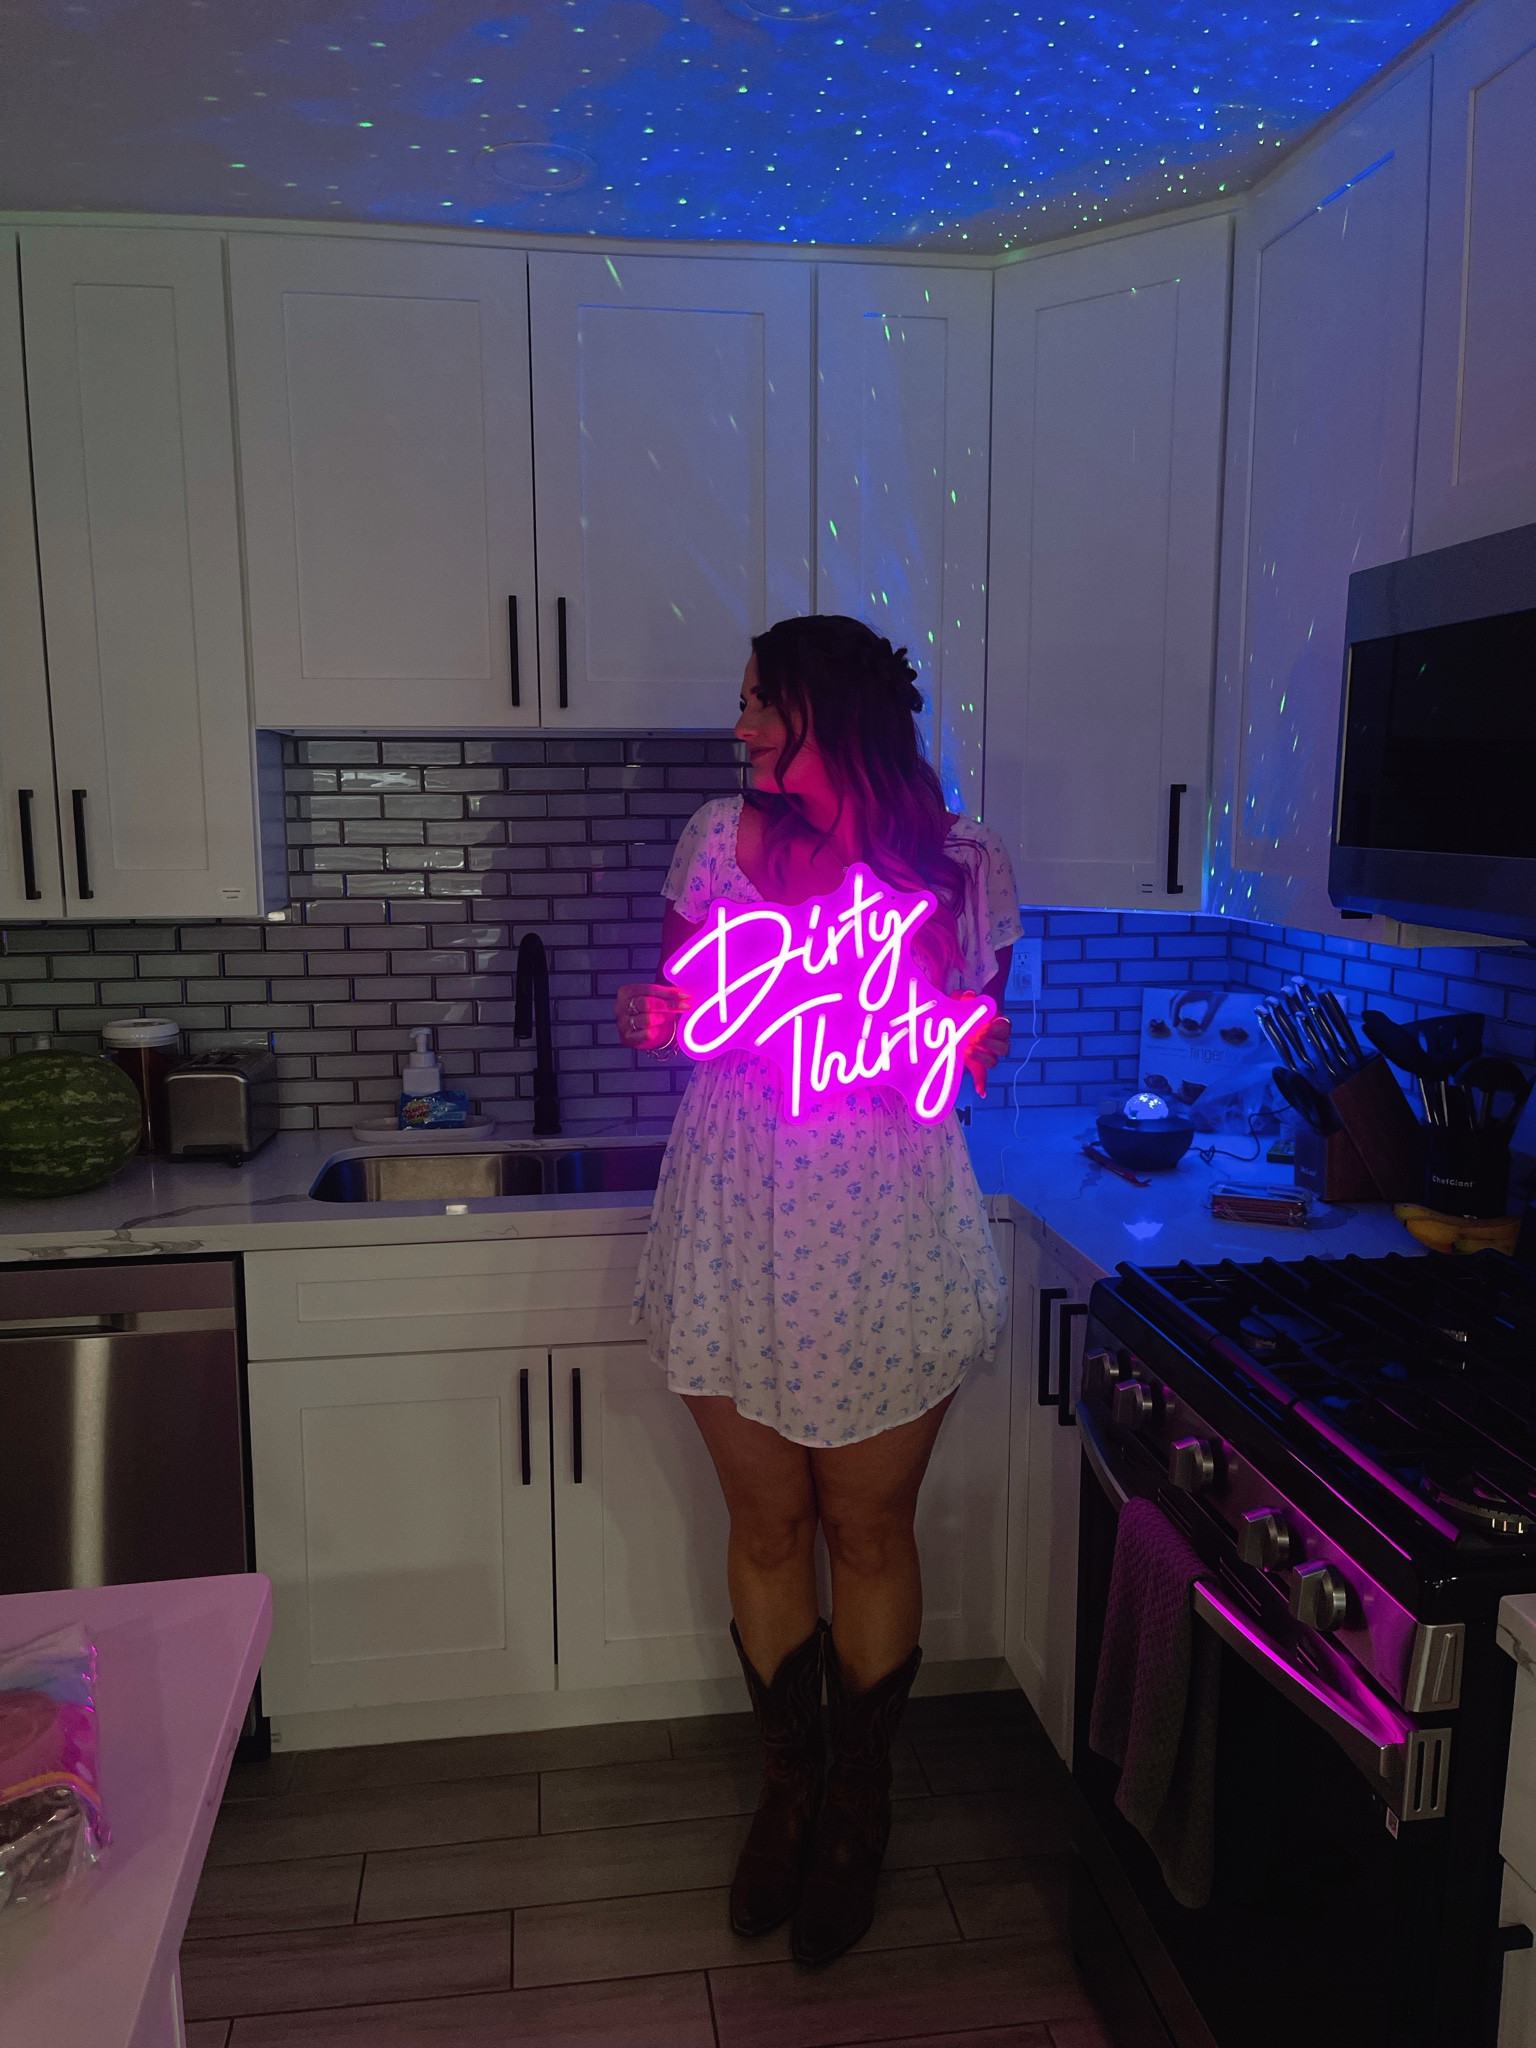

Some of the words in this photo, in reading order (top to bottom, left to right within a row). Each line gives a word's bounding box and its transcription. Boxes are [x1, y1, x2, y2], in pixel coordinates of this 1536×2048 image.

[670, 872, 929, 1053] Dirty
[754, 977, 988, 1119] Thirty
[1432, 1175, 1473, 1188] ChefGiant
